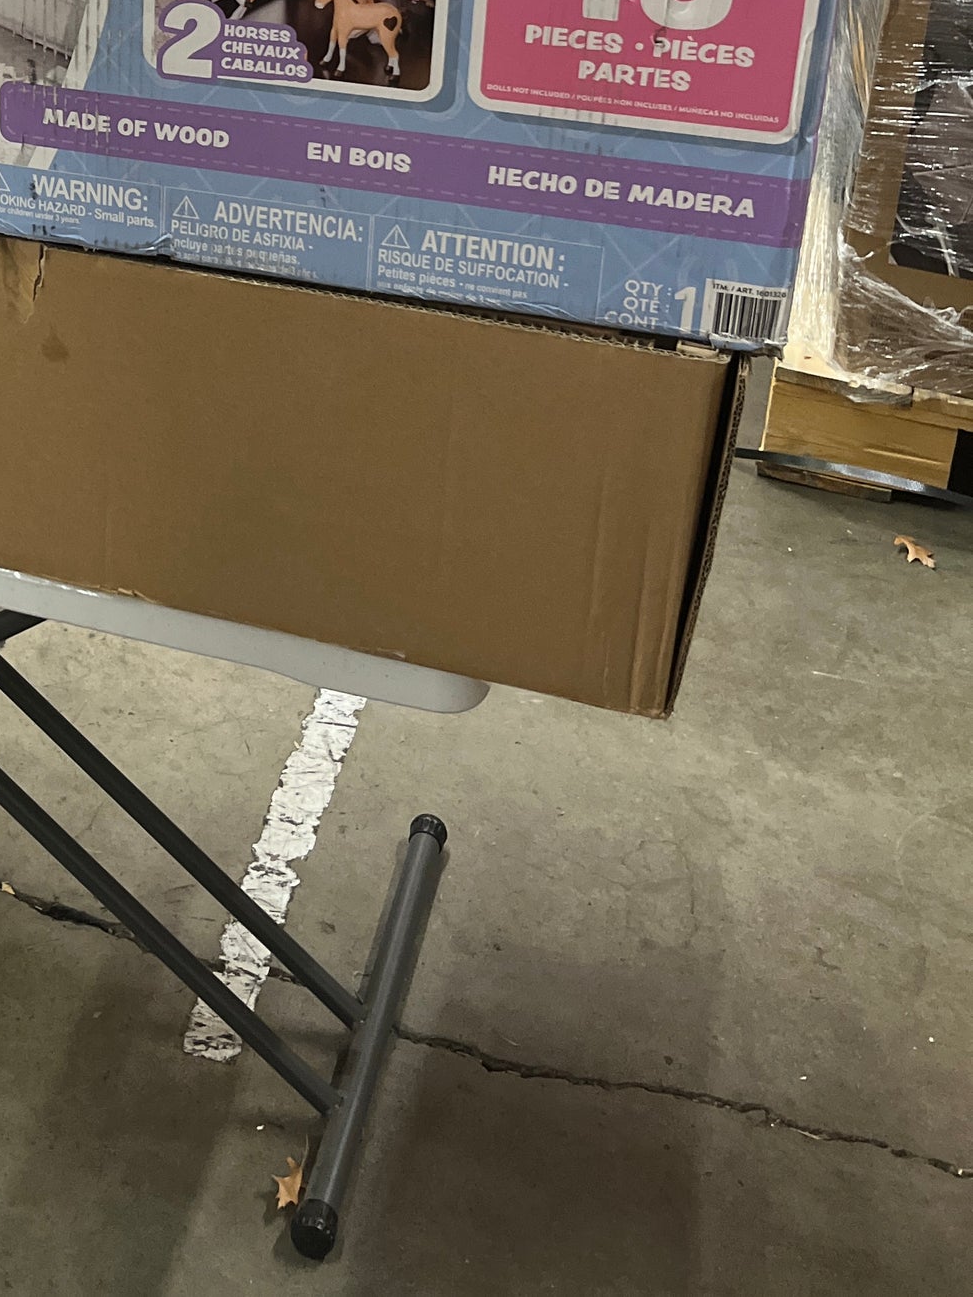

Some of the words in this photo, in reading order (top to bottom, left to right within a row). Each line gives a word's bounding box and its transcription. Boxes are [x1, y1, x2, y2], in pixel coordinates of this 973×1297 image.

[161, 2, 222, 79] 2
[223, 24, 291, 43] HORSES
[221, 40, 301, 60] CHEVAUX
[524, 24, 624, 54] PIECES
[653, 36, 756, 68] PIÈCES
[221, 57, 308, 79] CABALLOS
[577, 59, 692, 92] PARTES
[530, 88, 570, 100] INCLUDED
[634, 101, 672, 111] INCLUSES
[735, 112, 779, 124] INCLUIDAS
[43, 109, 111, 133] MADE
[118, 120, 146, 138] OF
[154, 122, 230, 149] WOOD
[306, 141, 341, 164] EN
[349, 148, 412, 174] BOIS
[32, 173, 148, 212] WARNING:
[487, 165, 578, 196] HECHO
[584, 179, 621, 201] DE
[628, 184, 755, 219] MADERA
[7, 206, 34, 218] children
[35, 212, 54, 221] under
[55, 214, 60, 222] 3
[39, 199, 86, 217] HAZARD
[94, 208, 124, 223] Small
[127, 214, 158, 229] parts.
[214, 200, 363, 243] ADVERTENCIA:
[171, 219, 228, 240] PELIGRO
[232, 227, 250, 243] DE
[253, 231, 305, 252] ASFIXIA
[421, 229, 554, 271] ATTENTION
[377, 265, 416, 282] Petites
[418, 271, 456, 289] pièces
[378, 248, 431, 269] RISQUE
[434, 257, 454, 273] DE
[457, 260, 560, 289] SUFFOCATION
[623, 295, 660, 314] QTÉ
[624, 279, 664, 297] QTY
[712, 282, 729, 292] ITM.
[736, 285, 754, 295] ART.
[674, 286, 697, 335] 1
